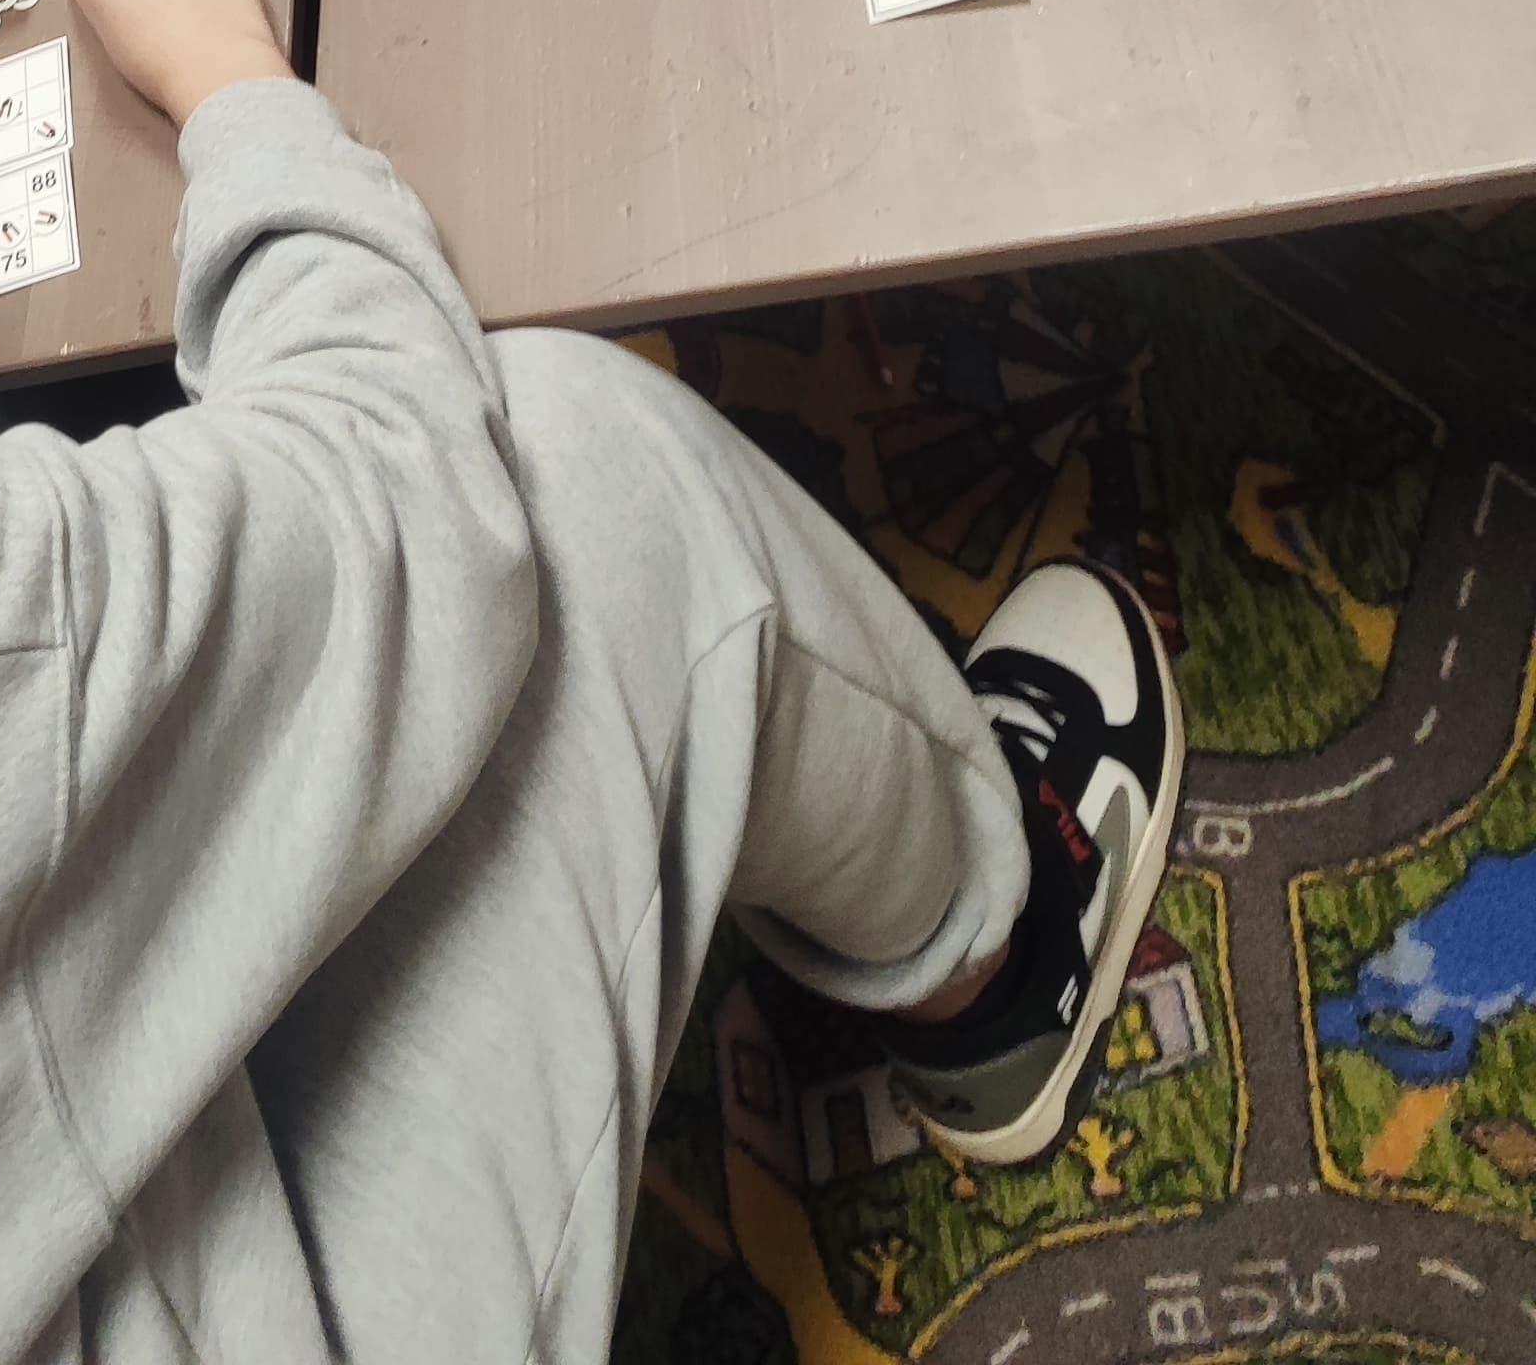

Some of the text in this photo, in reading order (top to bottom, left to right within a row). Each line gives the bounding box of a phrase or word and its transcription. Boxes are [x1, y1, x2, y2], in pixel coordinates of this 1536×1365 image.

[31, 170, 58, 193] 88
[0, 250, 28, 274] 75
[1145, 1243, 1381, 1346] BUS
